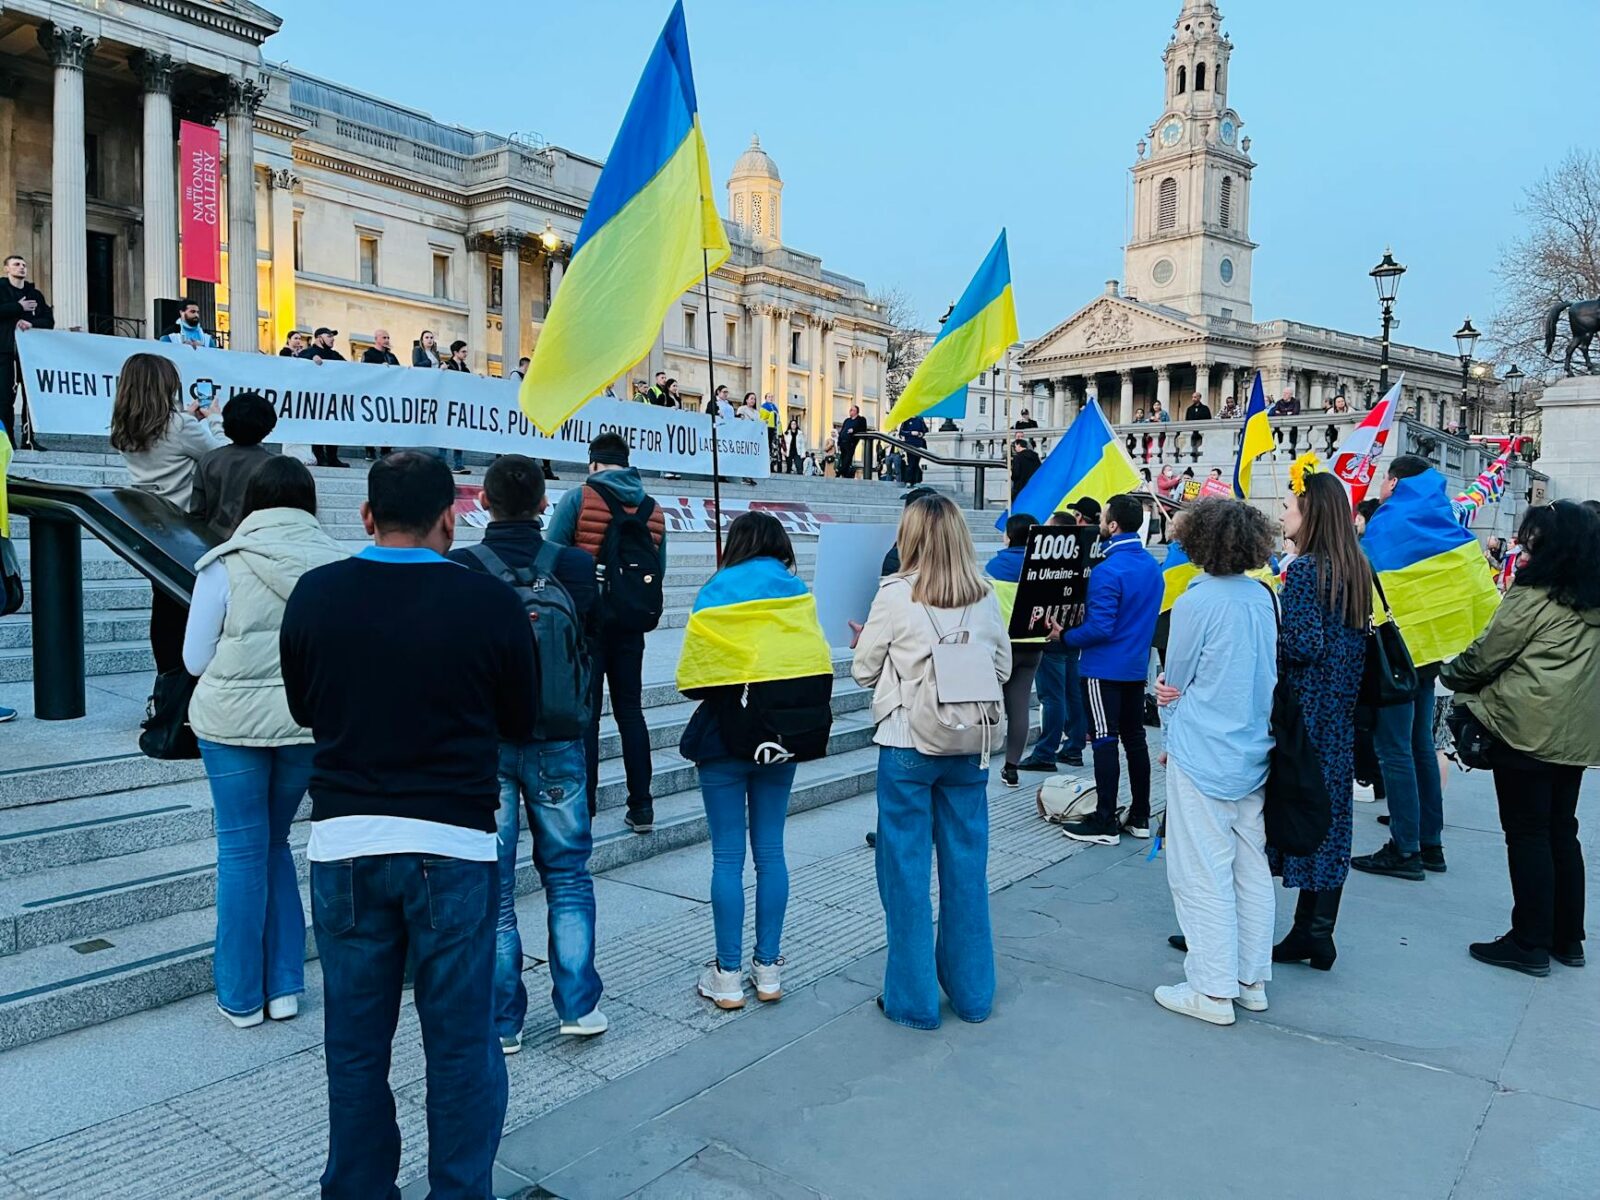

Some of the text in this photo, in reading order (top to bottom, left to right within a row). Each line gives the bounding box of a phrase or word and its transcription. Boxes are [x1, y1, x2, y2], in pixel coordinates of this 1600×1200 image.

[193, 149, 204, 222] NATIONAL
[204, 151, 216, 225] GALLERY
[36, 369, 97, 396] WHEN
[360, 395, 438, 424] SOLDIER
[447, 401, 503, 435] FALLS,
[560, 418, 592, 444] WILL
[640, 429, 662, 452] FOR
[666, 423, 697, 456] YOU
[699, 437, 728, 453] LADES
[735, 440, 760, 456] GENTS!
[1030, 534, 1080, 560] 1000s
[1027, 568, 1037, 581] in
[1063, 586, 1073, 597] to
